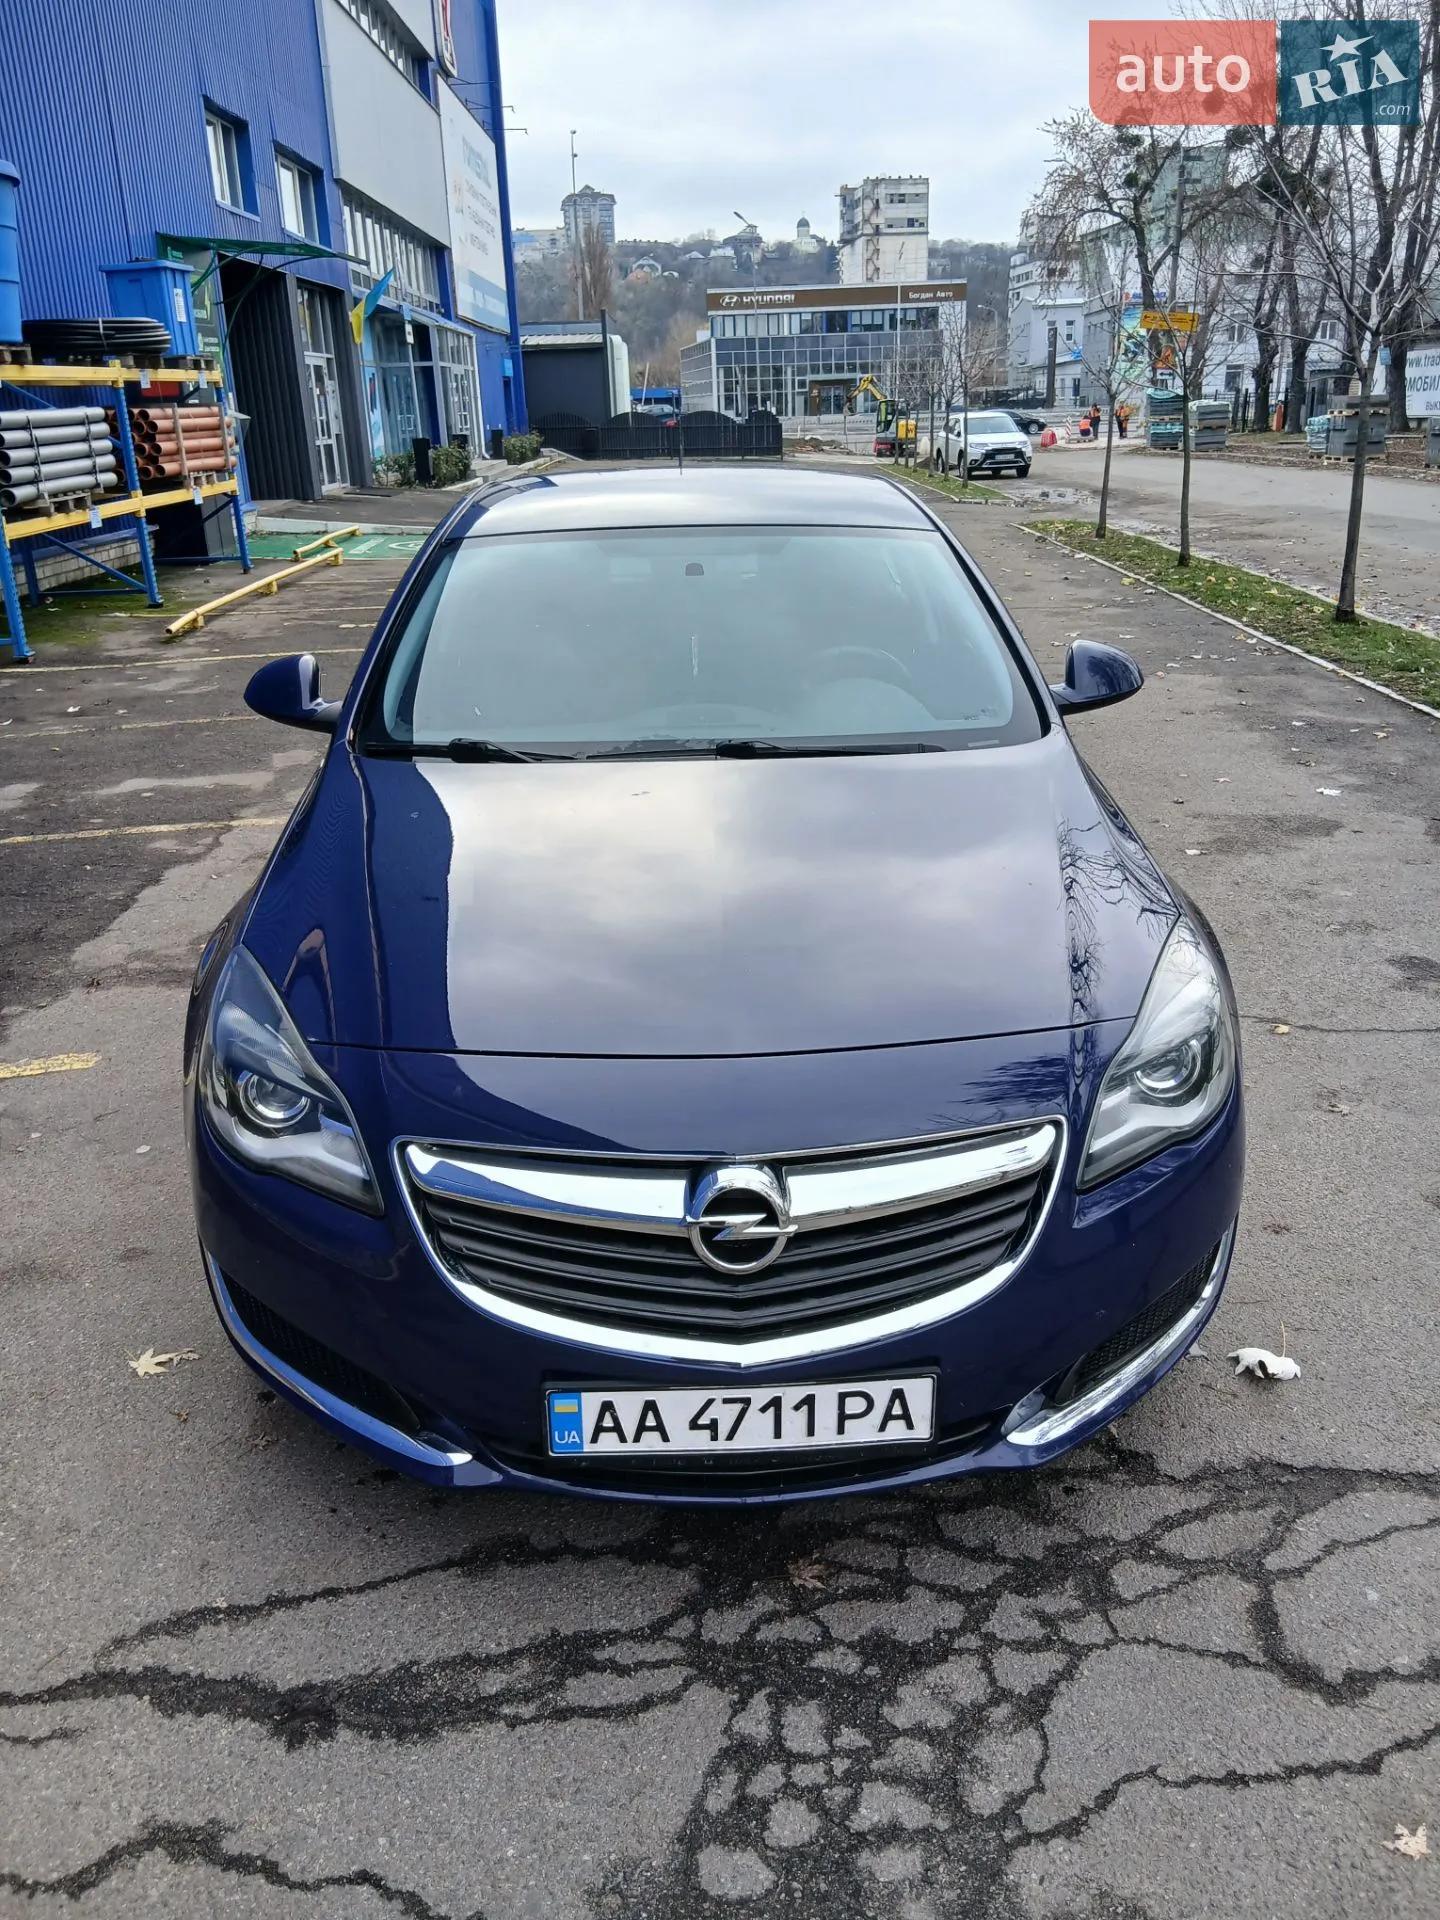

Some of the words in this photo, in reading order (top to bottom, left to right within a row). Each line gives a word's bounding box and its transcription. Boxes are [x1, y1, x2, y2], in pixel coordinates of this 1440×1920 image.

[742, 294, 795, 305] HYUNDAI
[908, 291, 934, 300] Богдан
[936, 290, 954, 298] Авто
[590, 1399, 670, 1445] AA
[688, 1393, 816, 1442] 4711
[836, 1387, 915, 1436] PA
[554, 1430, 581, 1445] UA
